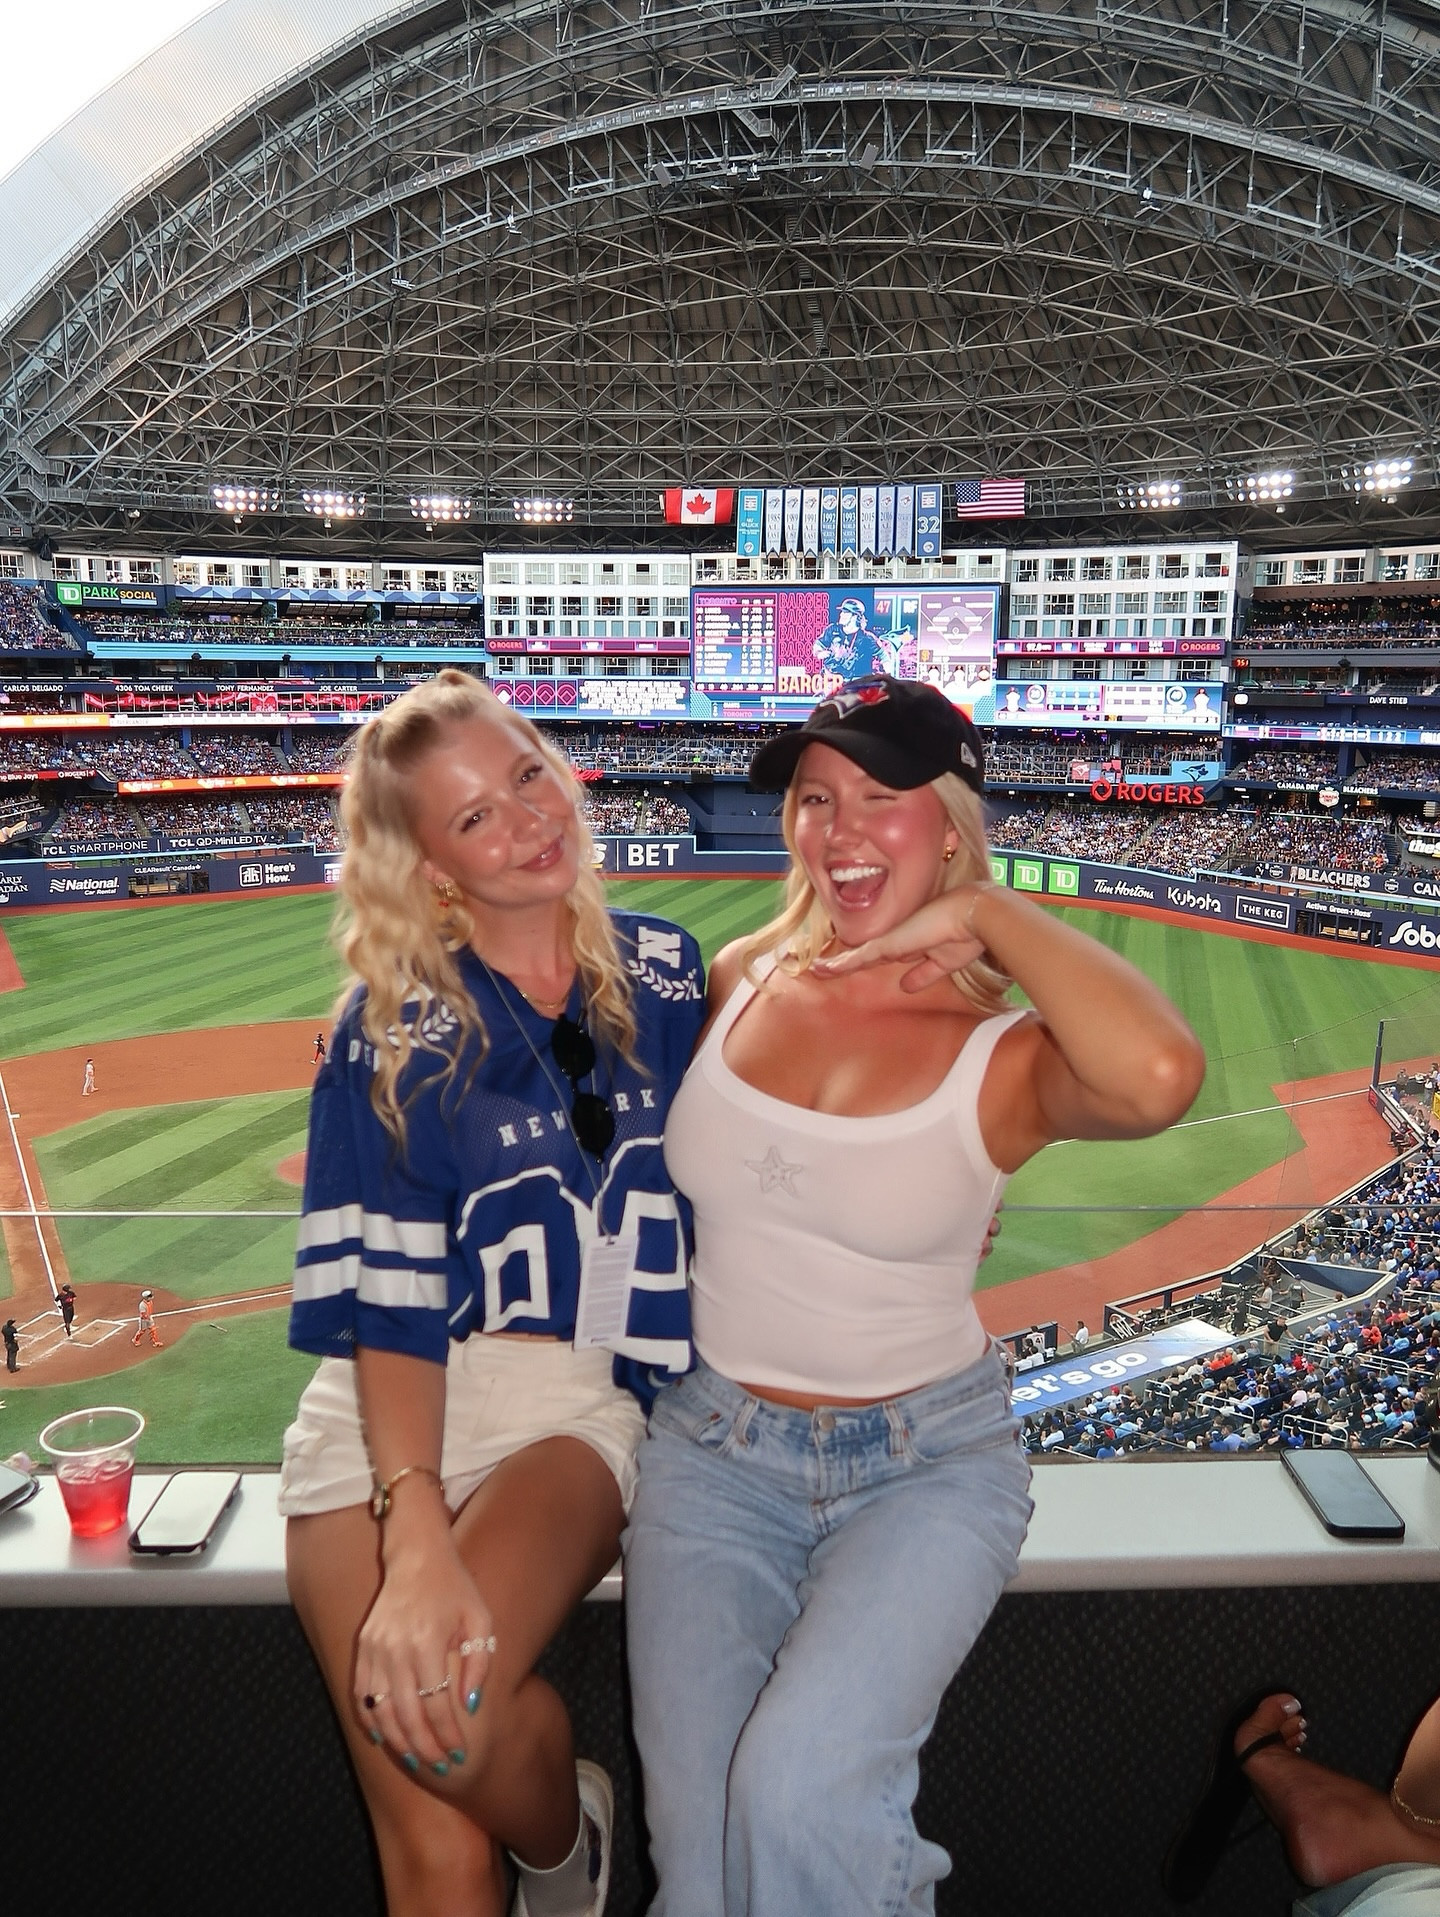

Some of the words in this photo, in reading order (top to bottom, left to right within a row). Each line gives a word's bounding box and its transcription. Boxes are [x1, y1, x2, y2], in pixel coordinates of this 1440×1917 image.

[823, 512, 836, 523] 1992
[842, 512, 856, 522] 1993
[917, 515, 940, 534] 32
[60, 587, 79, 601] TD
[83, 586, 119, 598] PARK
[120, 591, 157, 600] SOCIAL
[779, 593, 829, 609] BARGER
[876, 600, 890, 613] 47
[779, 609, 829, 625] BARGER
[779, 625, 826, 641] BARGE
[497, 641, 523, 649] ROGERS
[1191, 642, 1221, 651] ROGERS
[3, 684, 29, 692] CARLOS
[32, 684, 64, 692] DELGADO
[115, 684, 133, 692] 4306
[134, 684, 151, 692] TOM
[152, 684, 174, 692] CHEEK
[216, 684, 235, 692] TONY
[237, 684, 275, 692] FERNANDEZ
[1369, 697, 1387, 705] DAVE
[1388, 697, 1408, 705] STIEB
[23, 773, 39, 781] Jays
[1117, 784, 1206, 805] ROGERS
[1277, 782, 1305, 790] CANADA
[1342, 786, 1379, 795] BLEACHERS
[43, 846, 67, 855] TCL
[70, 841, 148, 853] SMARTPHONE
[169, 839, 195, 848] TCL
[254, 835, 268, 844] TV
[627, 844, 680, 866] BET
[265, 862, 296, 873] Here's
[991, 862, 1005, 880] D
[265, 874, 291, 884] How.
[1017, 865, 1040, 885] TD
[1053, 869, 1076, 889] TD
[1297, 868, 1371, 889] BLEACHERS
[1093, 878, 1112, 894] Tim
[1114, 880, 1155, 900] Hortons
[1167, 886, 1222, 913] Kubota
[1305, 901, 1328, 911] Active
[1242, 904, 1261, 916] THE
[1263, 907, 1285, 919] KEG
[498, 1109, 567, 1148] NEW
[1010, 1370, 1093, 1406] et's
[1089, 1353, 1148, 1378] go
